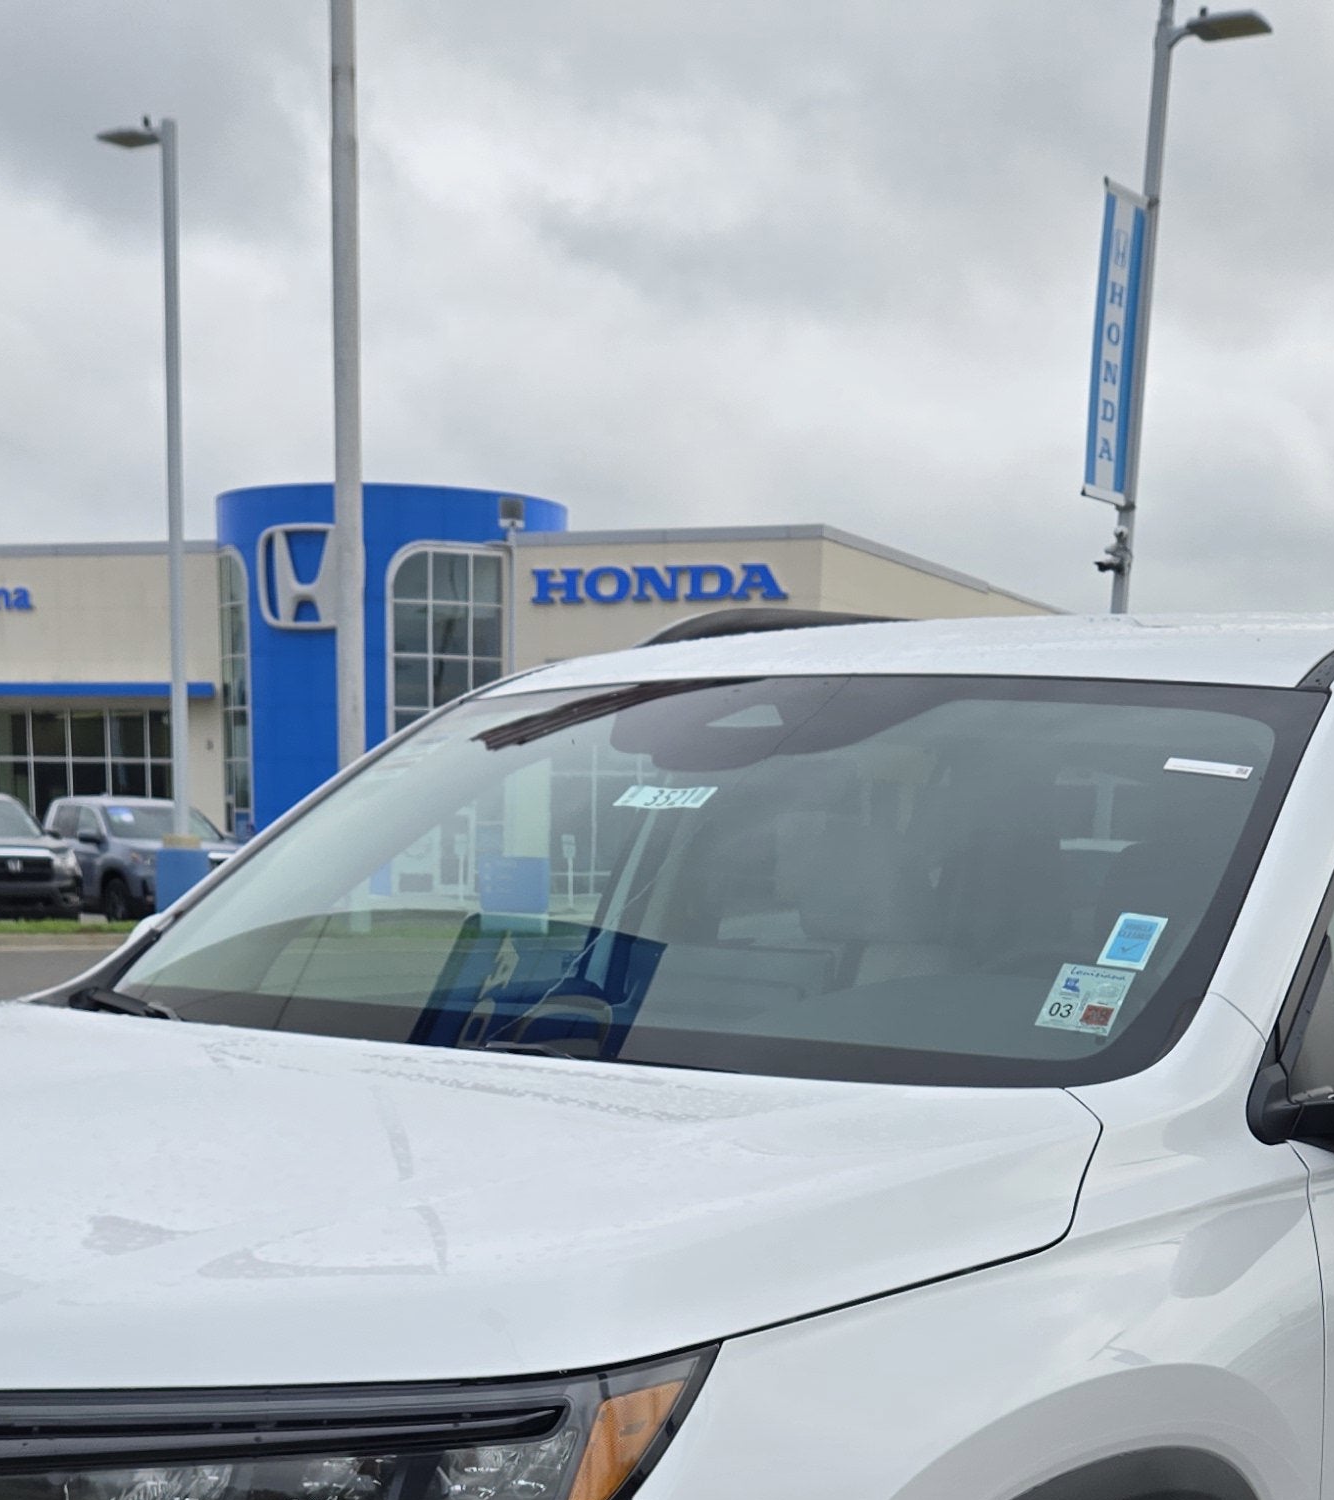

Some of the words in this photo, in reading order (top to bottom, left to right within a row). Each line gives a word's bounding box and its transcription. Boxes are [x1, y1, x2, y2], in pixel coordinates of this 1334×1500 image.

[1098, 281, 1124, 461] HONDA
[530, 563, 789, 604] HONDA
[643, 788, 700, 807] 3521
[1048, 1001, 1074, 1019] 03
